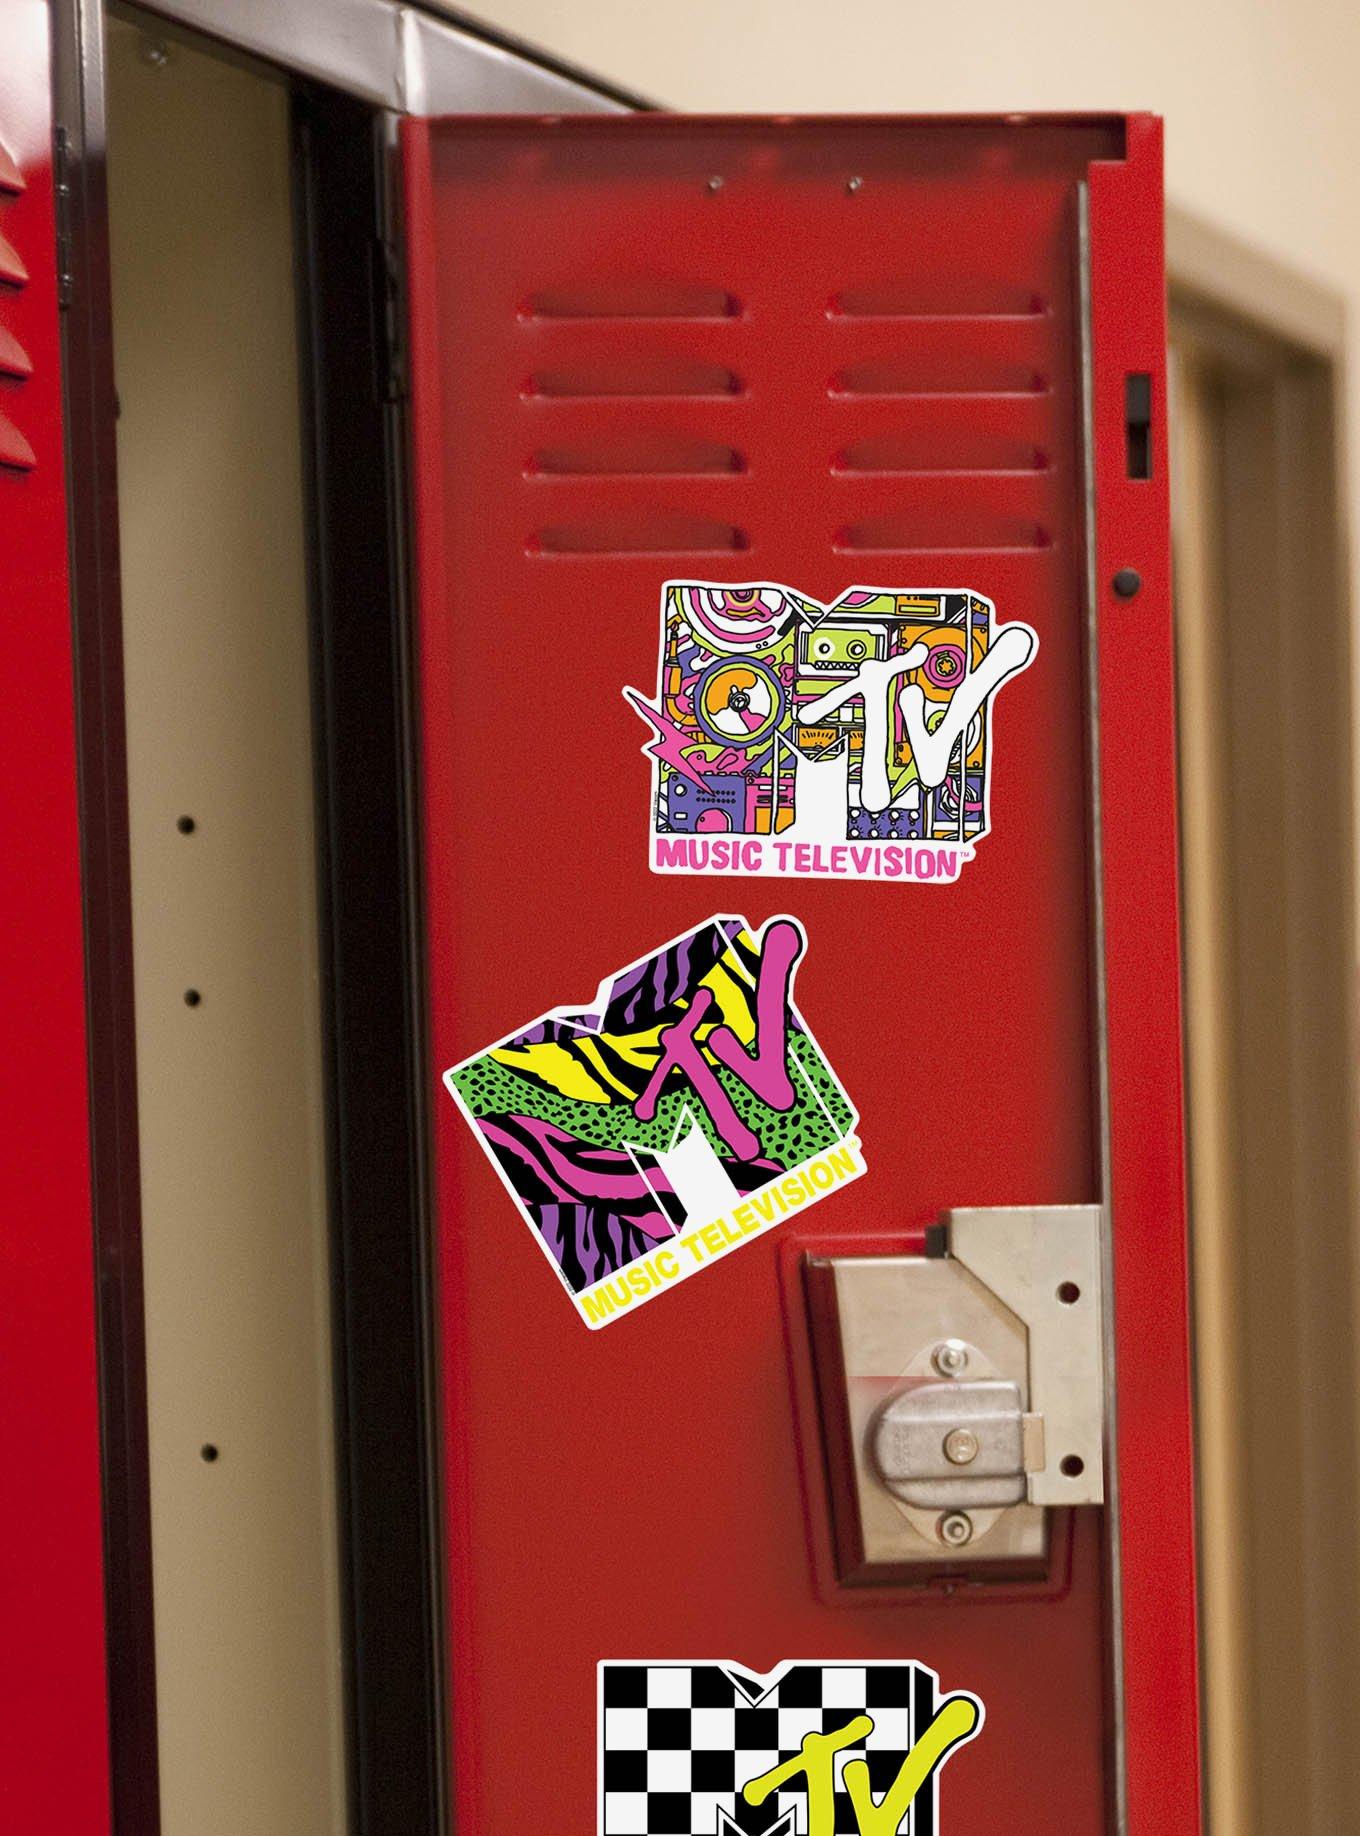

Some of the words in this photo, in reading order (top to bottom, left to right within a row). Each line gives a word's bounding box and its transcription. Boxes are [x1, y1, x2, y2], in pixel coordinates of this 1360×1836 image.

[656, 586, 1034, 843] MTV
[656, 838, 763, 872] MUSIC
[772, 842, 957, 880] TELEVISION
[449, 918, 856, 1296] MTV
[580, 1250, 681, 1324] MUSIC
[679, 1146, 858, 1263] TELEVISION
[603, 1665, 980, 1836] MTV
